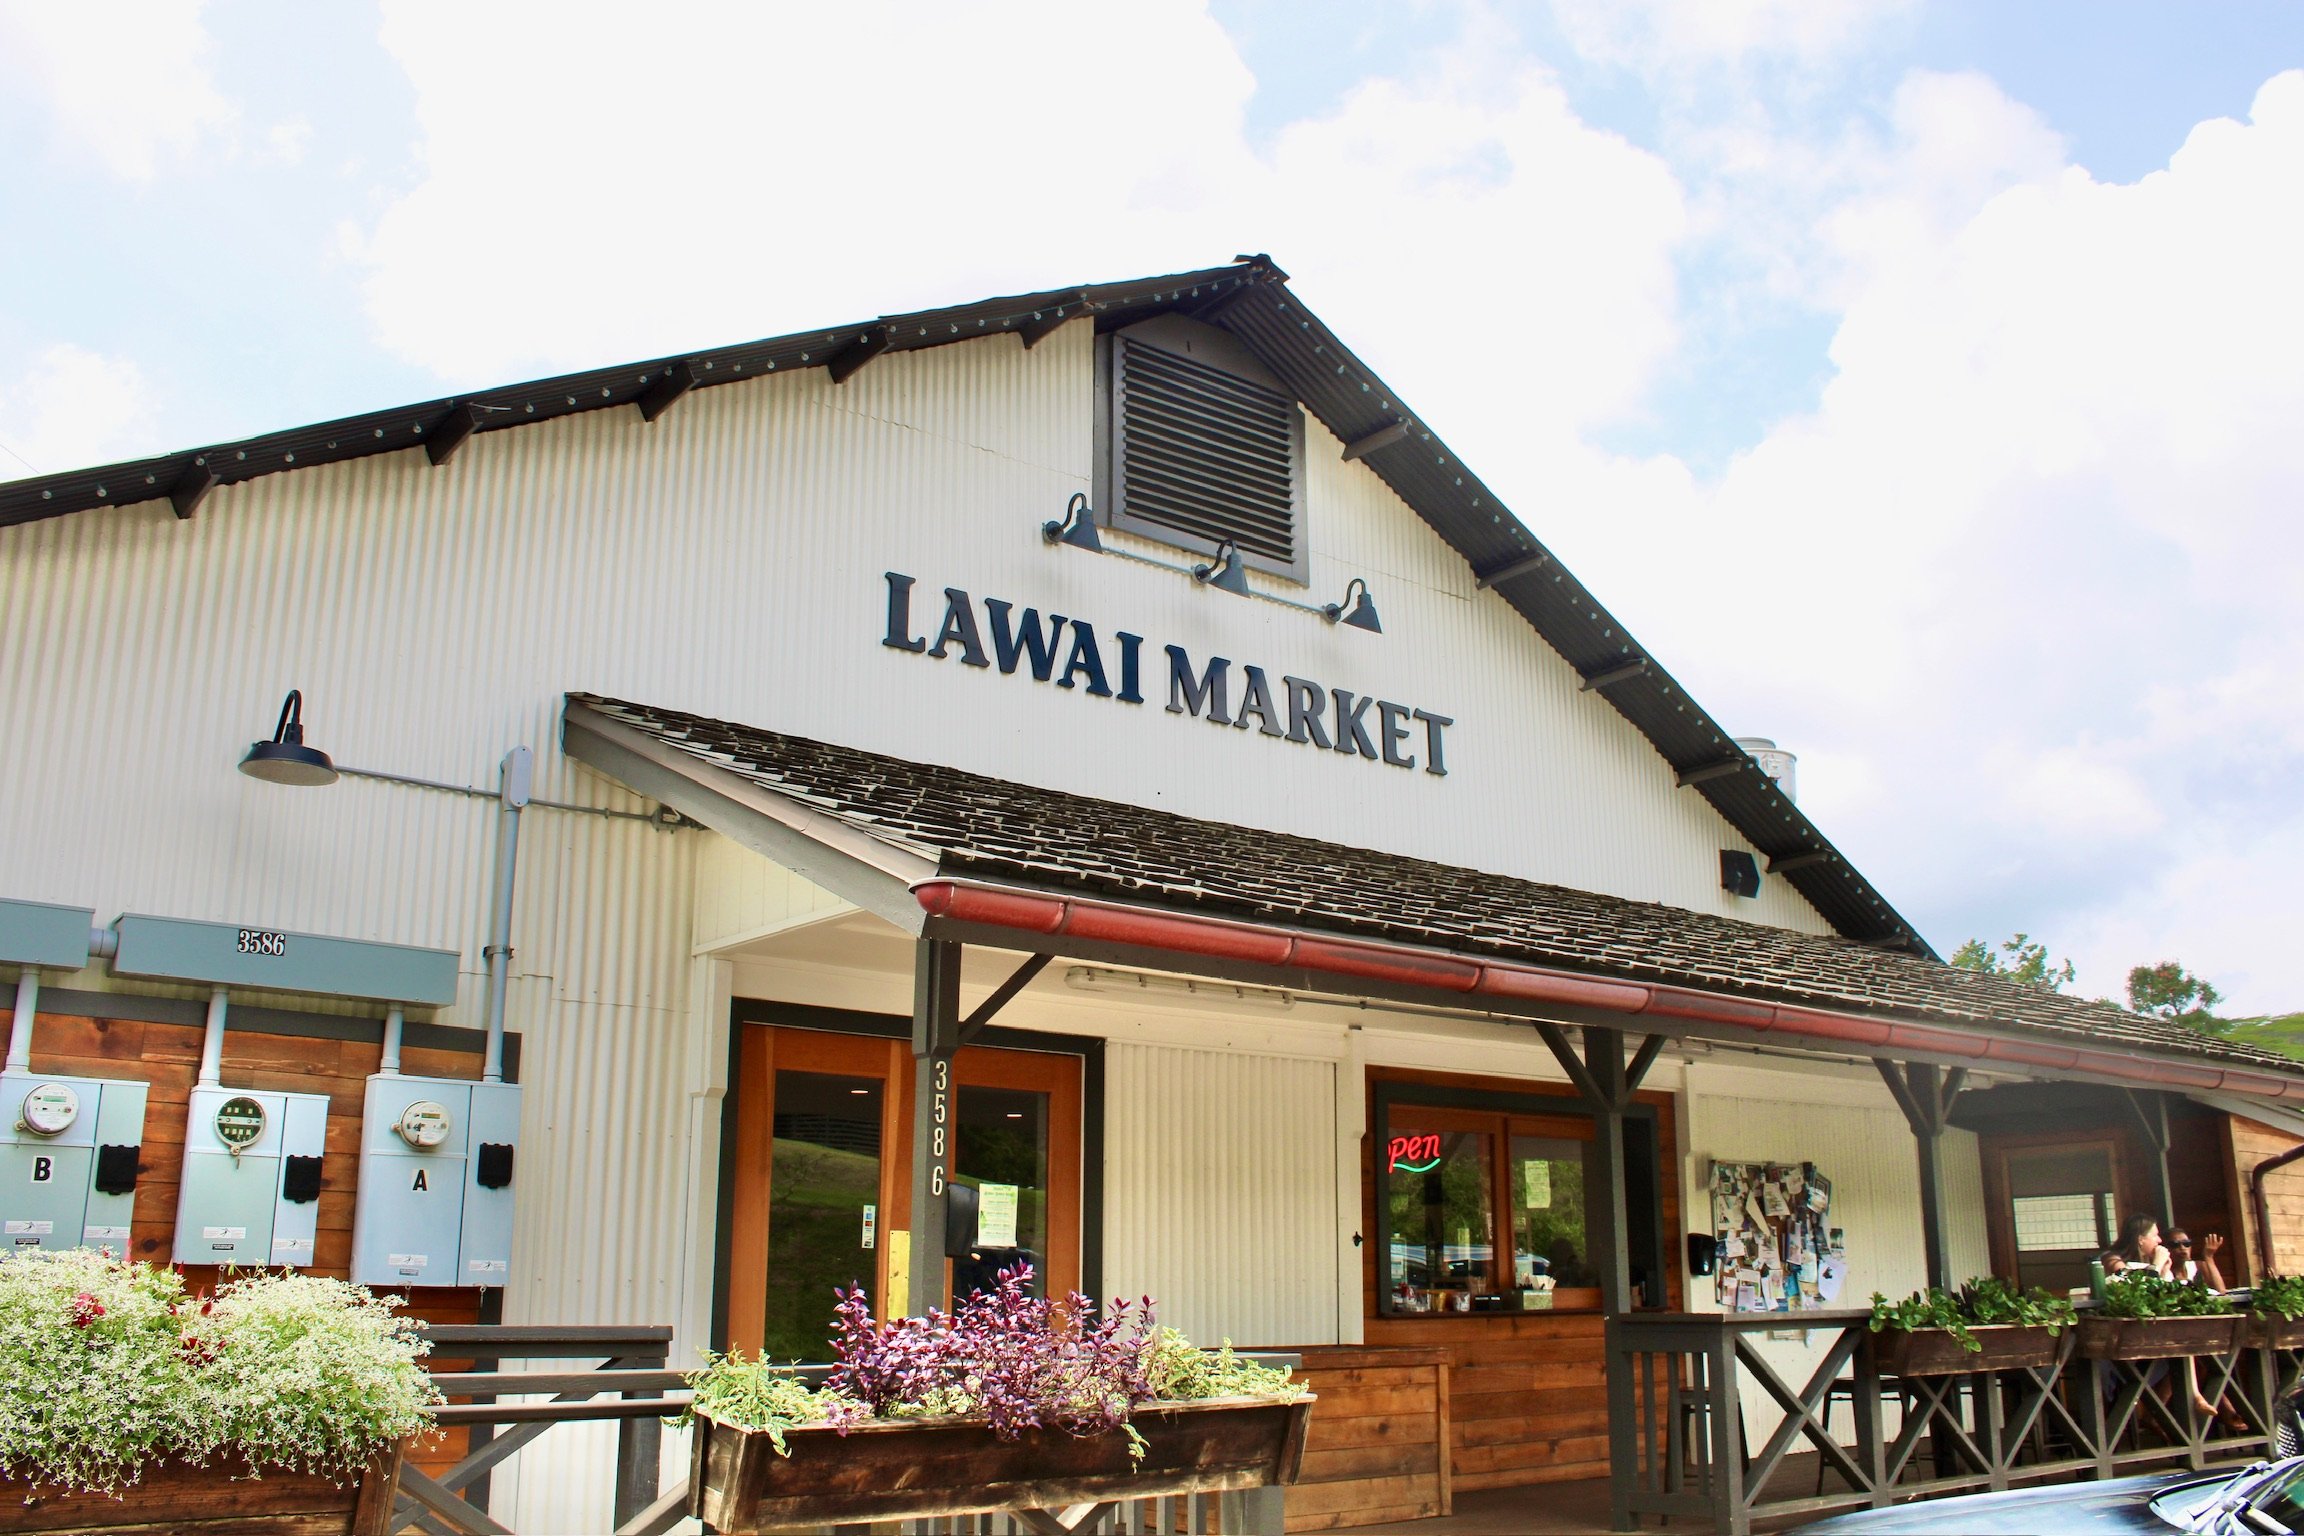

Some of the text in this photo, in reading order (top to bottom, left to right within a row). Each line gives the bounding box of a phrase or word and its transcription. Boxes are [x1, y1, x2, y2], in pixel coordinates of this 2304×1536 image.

[882, 571, 1454, 776] LAWAI MARKET
[237, 930, 285, 956] 3586
[931, 1060, 947, 1197] 3586
[34, 1157, 50, 1181] B
[1388, 1134, 1440, 1174] pen
[412, 1171, 428, 1191] A
